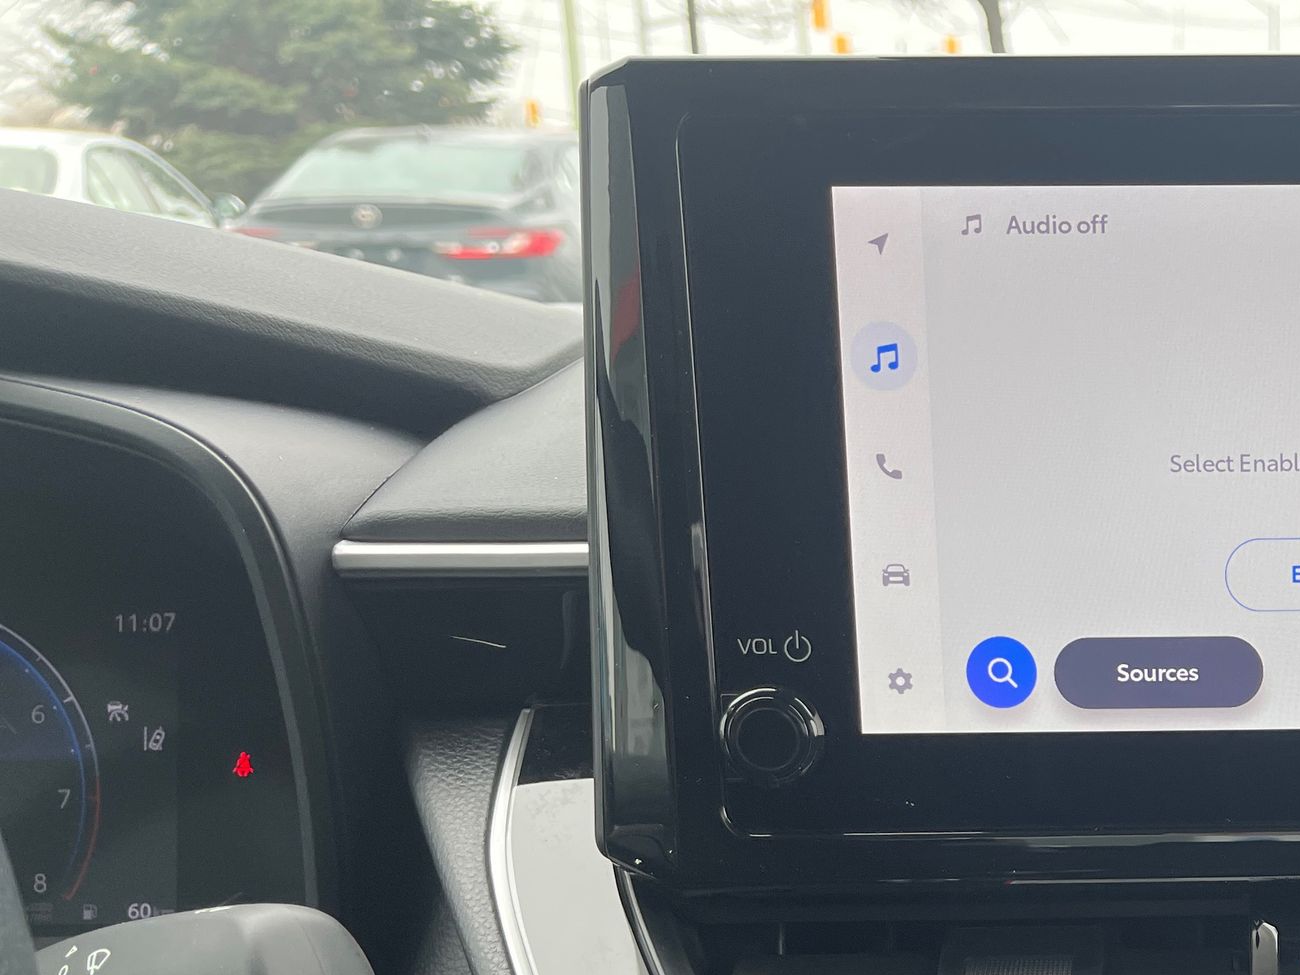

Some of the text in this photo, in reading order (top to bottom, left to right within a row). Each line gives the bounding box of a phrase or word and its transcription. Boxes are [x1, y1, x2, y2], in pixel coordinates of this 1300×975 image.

[1006, 214, 1108, 235] Audio off
[1170, 454, 1235, 474] Select
[115, 612, 176, 632] 11:07
[737, 638, 778, 655] VOL
[1116, 663, 1199, 682] Sources
[31, 704, 46, 724] 6
[57, 788, 70, 810] 7
[33, 873, 48, 894] 8
[128, 902, 152, 920] 60
